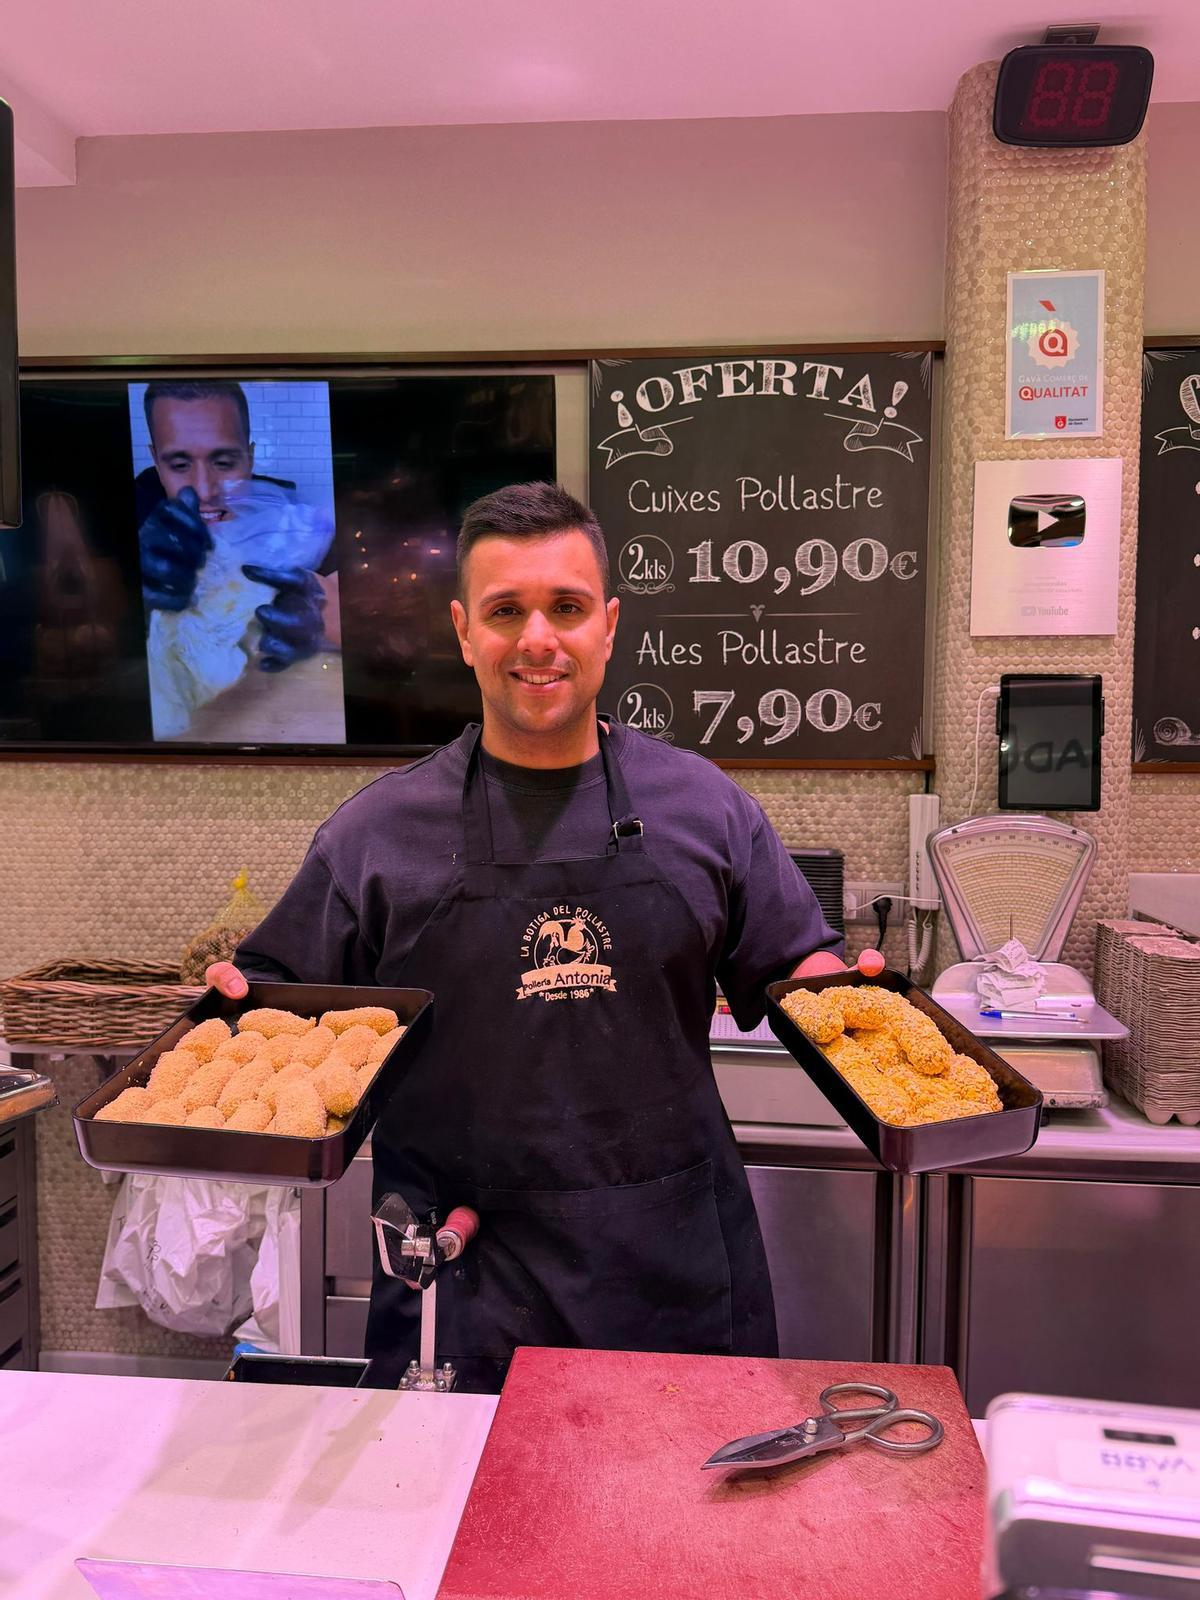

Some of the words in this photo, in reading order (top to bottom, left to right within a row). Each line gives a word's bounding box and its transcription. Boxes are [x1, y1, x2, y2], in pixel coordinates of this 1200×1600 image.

[610, 359, 909, 428] ¡OFERTA!
[1018, 386, 1089, 401] QUALITAT
[629, 479, 720, 513] Cuixes
[736, 474, 884, 511] Pollastre
[687, 537, 918, 596] 10,90€
[636, 630, 702, 666] Ales
[718, 628, 866, 665] Pollastre
[692, 688, 883, 745] 7,90€
[522, 911, 551, 942] BOTIGA
[552, 905, 571, 916] DEL
[576, 906, 613, 951] POLLASTRE
[520, 945, 530, 957] LA
[554, 969, 611, 986] Antonia
